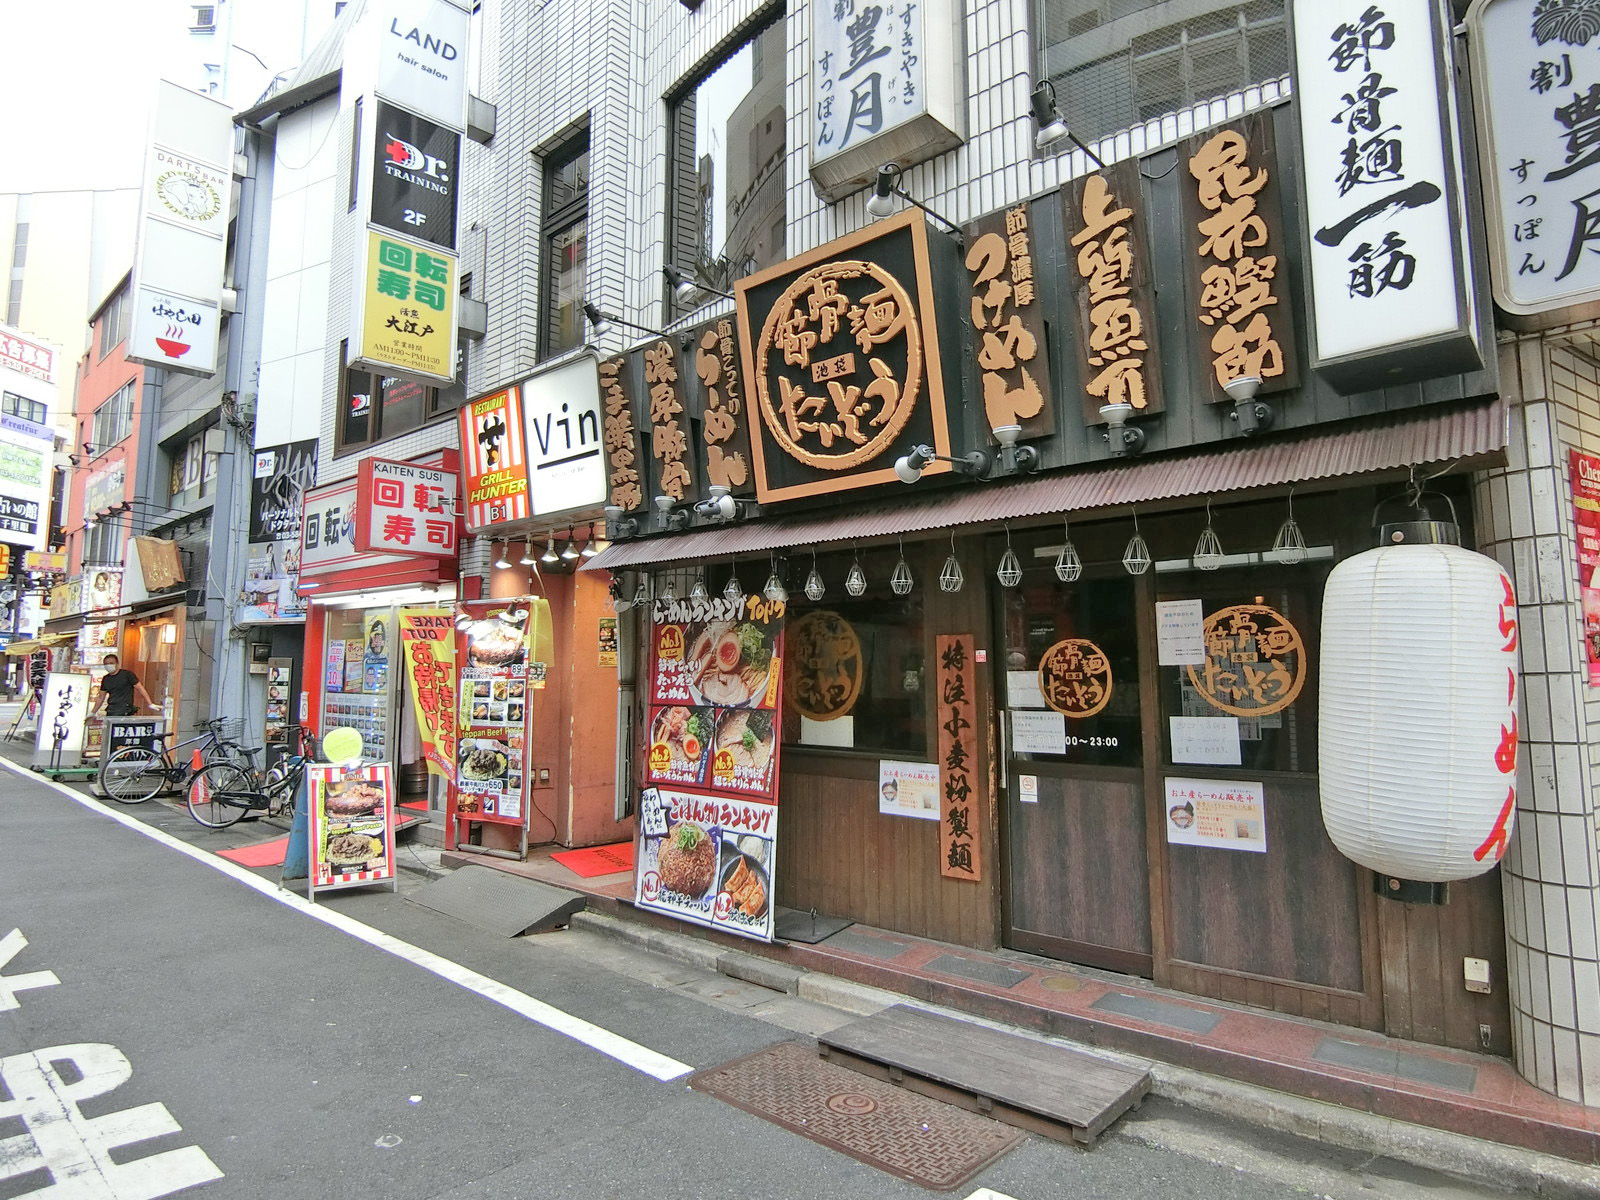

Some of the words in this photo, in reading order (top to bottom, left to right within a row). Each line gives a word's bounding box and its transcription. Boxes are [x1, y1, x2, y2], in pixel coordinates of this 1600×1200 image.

[389, 17, 458, 62] LAND
[899, 2, 918, 106] すきやき
[397, 52, 419, 68] hair
[421, 64, 449, 81] salon
[838, 4, 892, 151] 豊月
[1528, 53, 1574, 95] 割
[817, 50, 836, 147] すっぽん
[157, 152, 201, 175] DARTS
[202, 173, 225, 186] BAR
[1313, 5, 1442, 299] 節骨麺一筋
[385, 164, 448, 196] TRAINING
[402, 208, 427, 227] 2F
[1509, 157, 1546, 277] すっぽん
[379, 240, 449, 285] 回転
[1005, 202, 1036, 308] 節骨濃厚
[377, 268, 446, 312] 寿司
[384, 315, 435, 338] 大江戸
[775, 278, 902, 369] 節骨麺
[964, 231, 1045, 431] つけめん
[393, 338, 423, 352] 営業時間
[717, 319, 742, 416] 節骨こってり
[814, 357, 848, 379] 池袋
[474, 394, 507, 416] RESTAURANT
[694, 330, 749, 489] らーめん
[778, 356, 901, 449] たいぞう
[533, 402, 599, 456] Vin
[374, 462, 415, 478] KAITEN
[418, 470, 443, 482] SUSI
[480, 469, 514, 487] GRILL
[373, 477, 445, 514] 回転
[470, 478, 527, 503] HUNTER
[305, 507, 341, 550] 回転
[490, 504, 507, 521] B1
[383, 514, 454, 549] 寿司
[653, 594, 748, 625] らーめんランキング
[1048, 643, 1106, 677] 節骨麺
[657, 686, 690, 700] らーめん
[1047, 674, 1104, 709] たいぞう
[1203, 659, 1292, 705] たいぞう
[113, 726, 147, 738] BAR
[462, 728, 486, 738] teppan
[487, 726, 503, 737] Beef
[941, 638, 975, 874] 特注小麦粉製麺
[1171, 789, 1255, 803] お土産らーめん販売中
